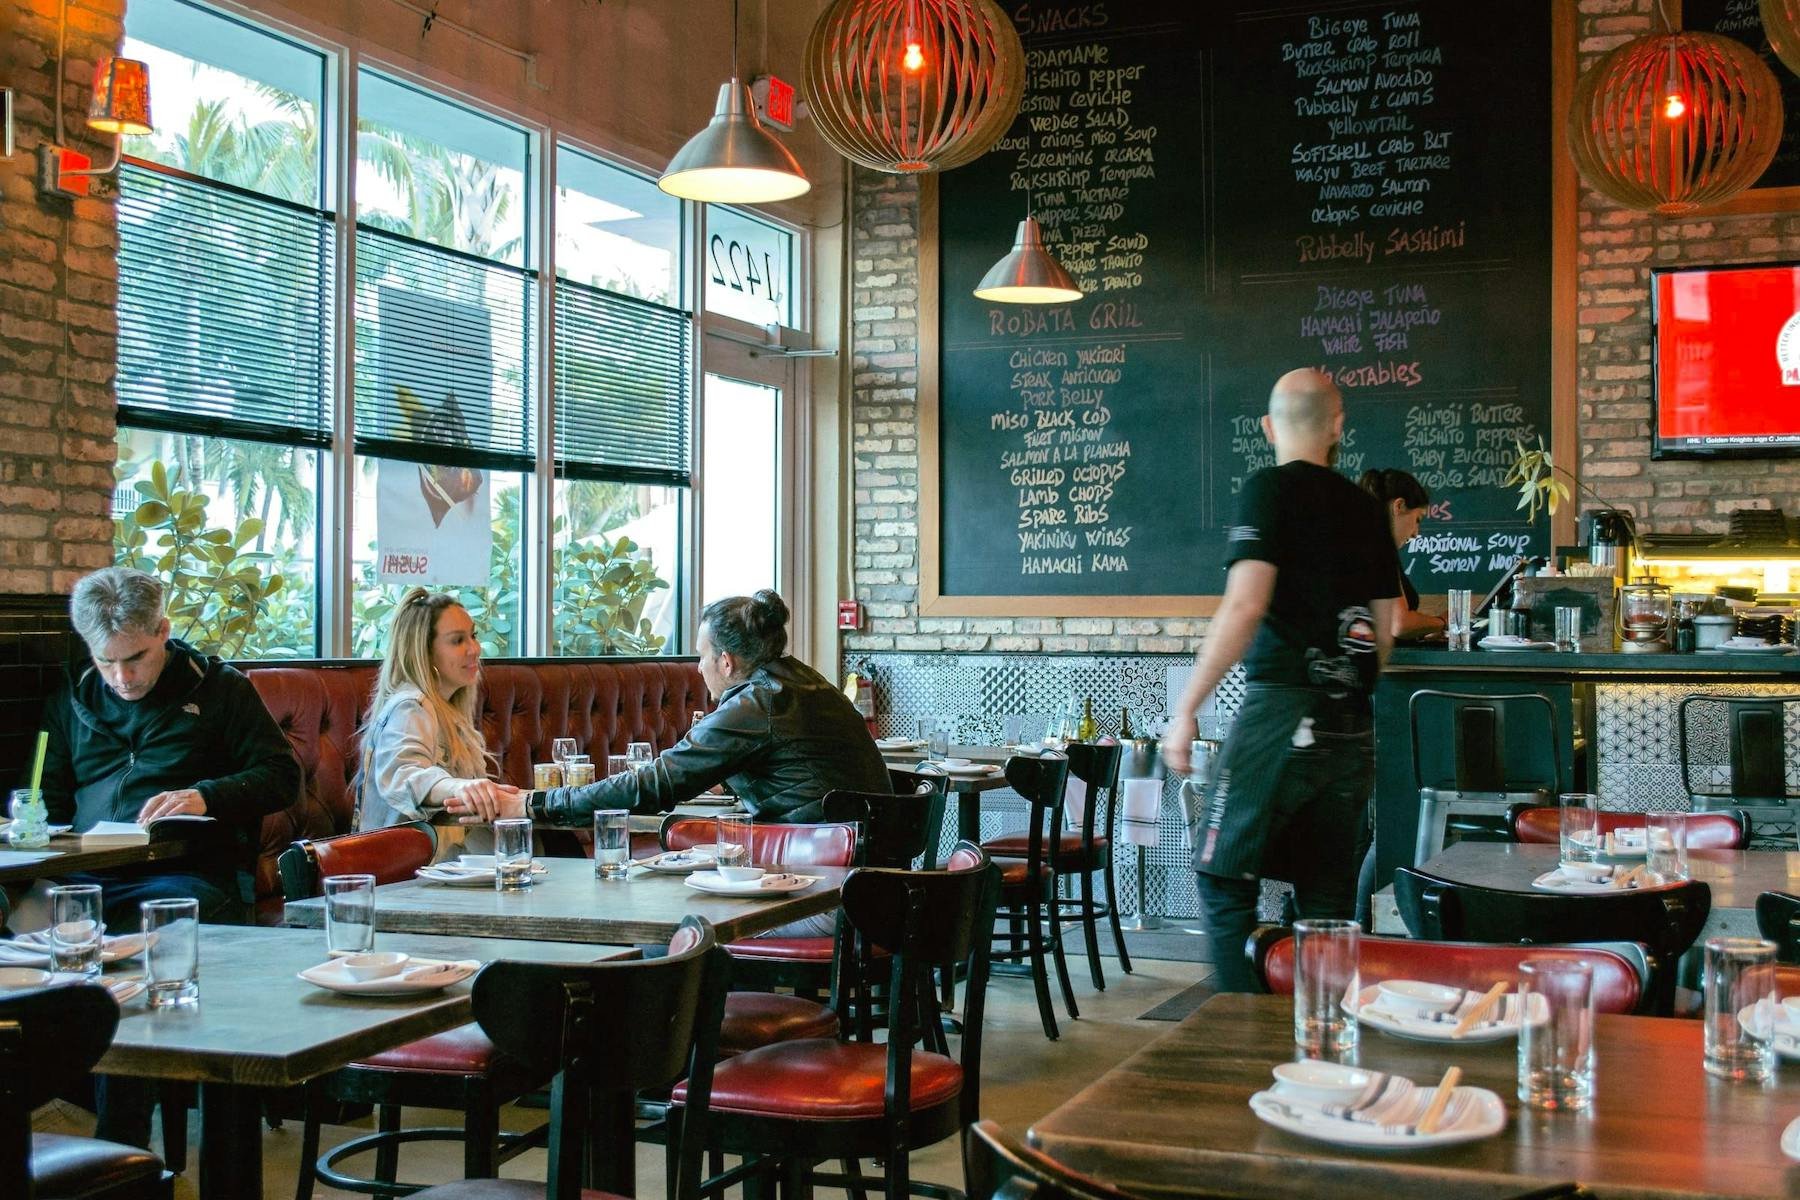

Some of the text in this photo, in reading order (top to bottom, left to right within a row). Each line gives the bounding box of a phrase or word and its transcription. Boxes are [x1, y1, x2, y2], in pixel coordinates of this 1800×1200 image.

[769, 76, 795, 127] EXIT
[1085, 107, 1130, 129] SALAD
[1424, 131, 1452, 150] BLT
[1036, 410, 1075, 428] BLACK
[1053, 448, 1061, 463] A
[1064, 447, 1078, 461] LA
[1092, 552, 1128, 572] KAMA
